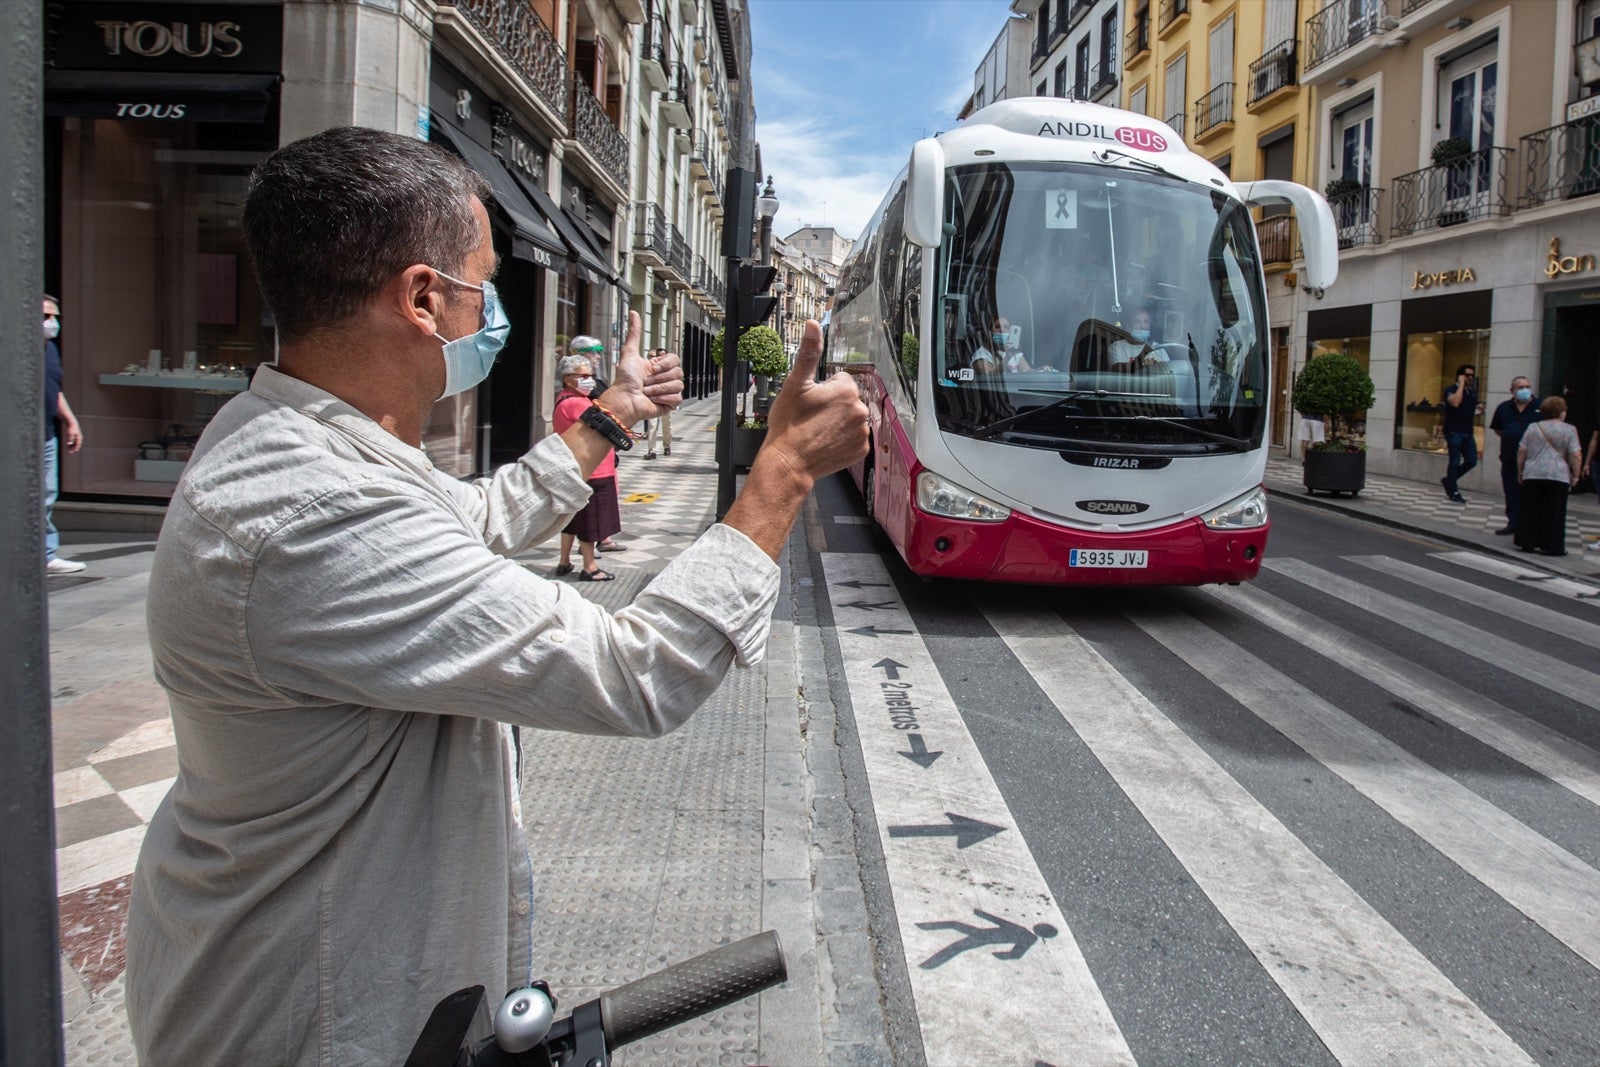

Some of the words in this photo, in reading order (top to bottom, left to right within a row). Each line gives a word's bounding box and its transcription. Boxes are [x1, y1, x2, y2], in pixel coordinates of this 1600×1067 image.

[95, 20, 243, 58] TOUS
[116, 103, 186, 119] TOUS
[532, 246, 551, 267] TOUS
[1093, 457, 1140, 469] IRIZAR
[1086, 501, 1138, 513] SCANIA
[1079, 551, 1115, 566] 5935
[1119, 552, 1145, 566] JVJ
[882, 690, 921, 730] metros
